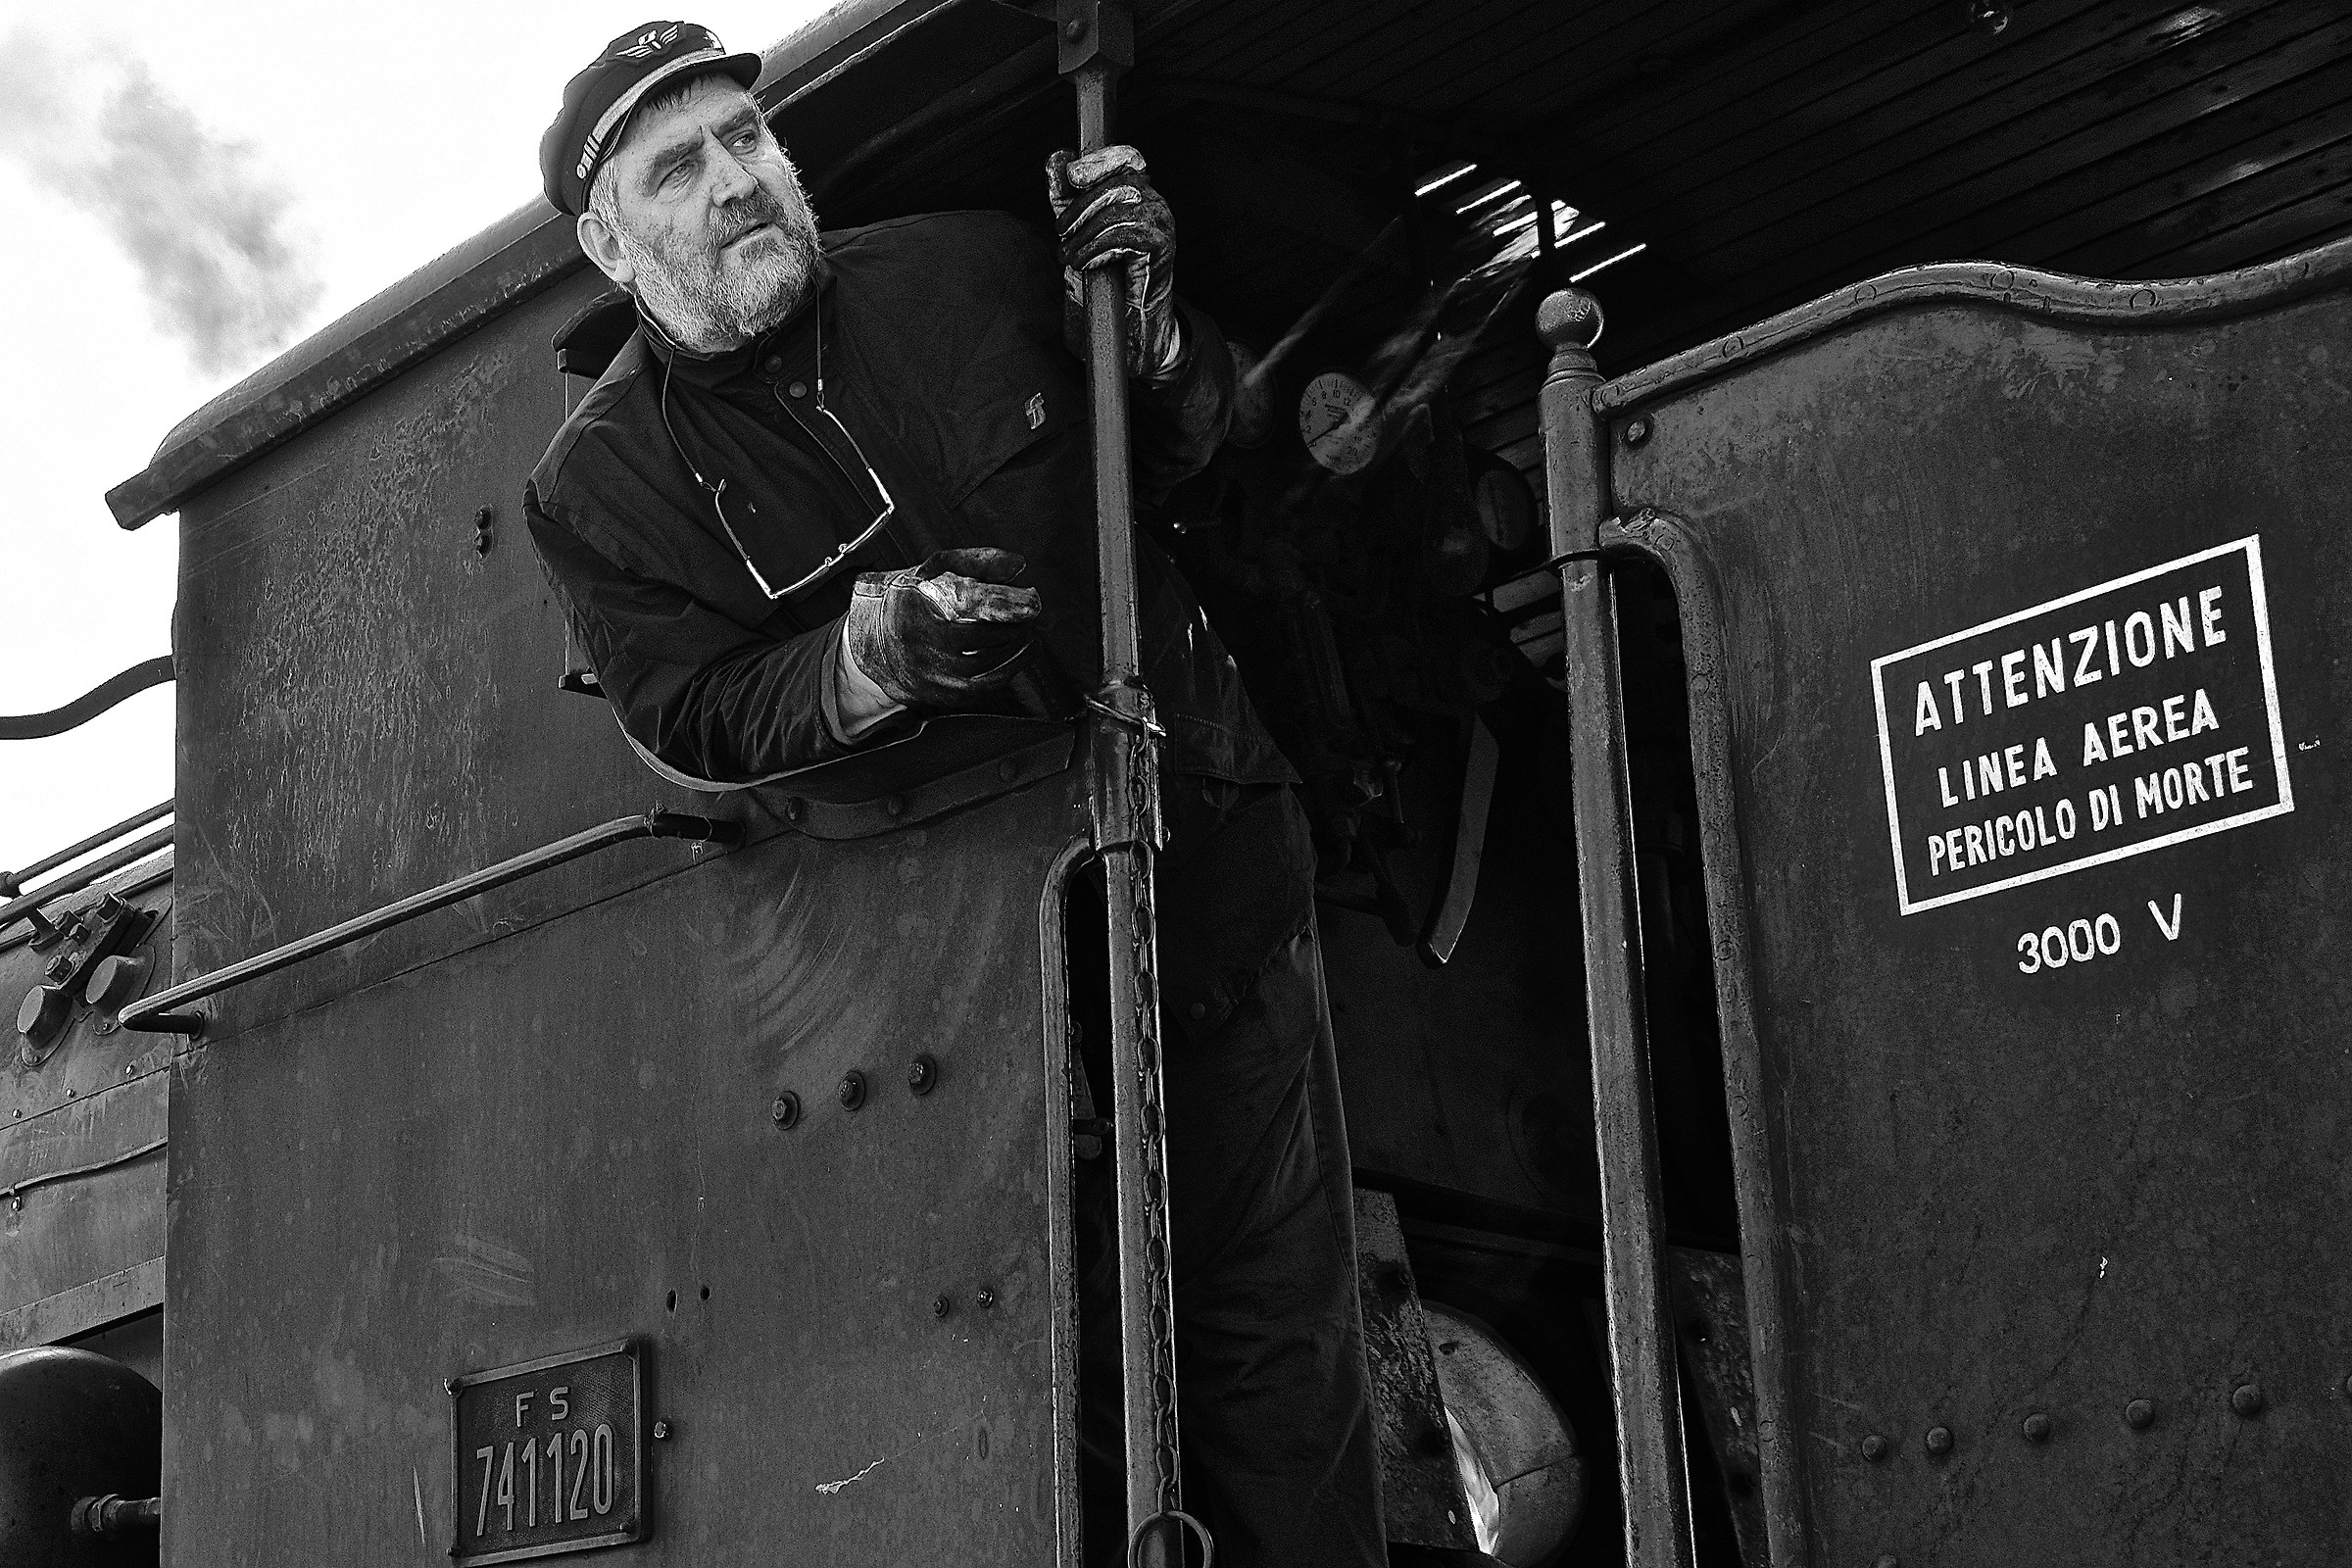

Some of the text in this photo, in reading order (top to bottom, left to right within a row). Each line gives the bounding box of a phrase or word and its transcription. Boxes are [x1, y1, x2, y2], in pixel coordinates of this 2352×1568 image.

[1915, 585, 2227, 737] ATTENZIONE
[1937, 688, 2220, 808] LINEA AEREA
[1927, 745, 2254, 877] PERICOLO DI MORTE
[2017, 893, 2182, 974] 3000 V
[476, 1423, 612, 1537] 741120
